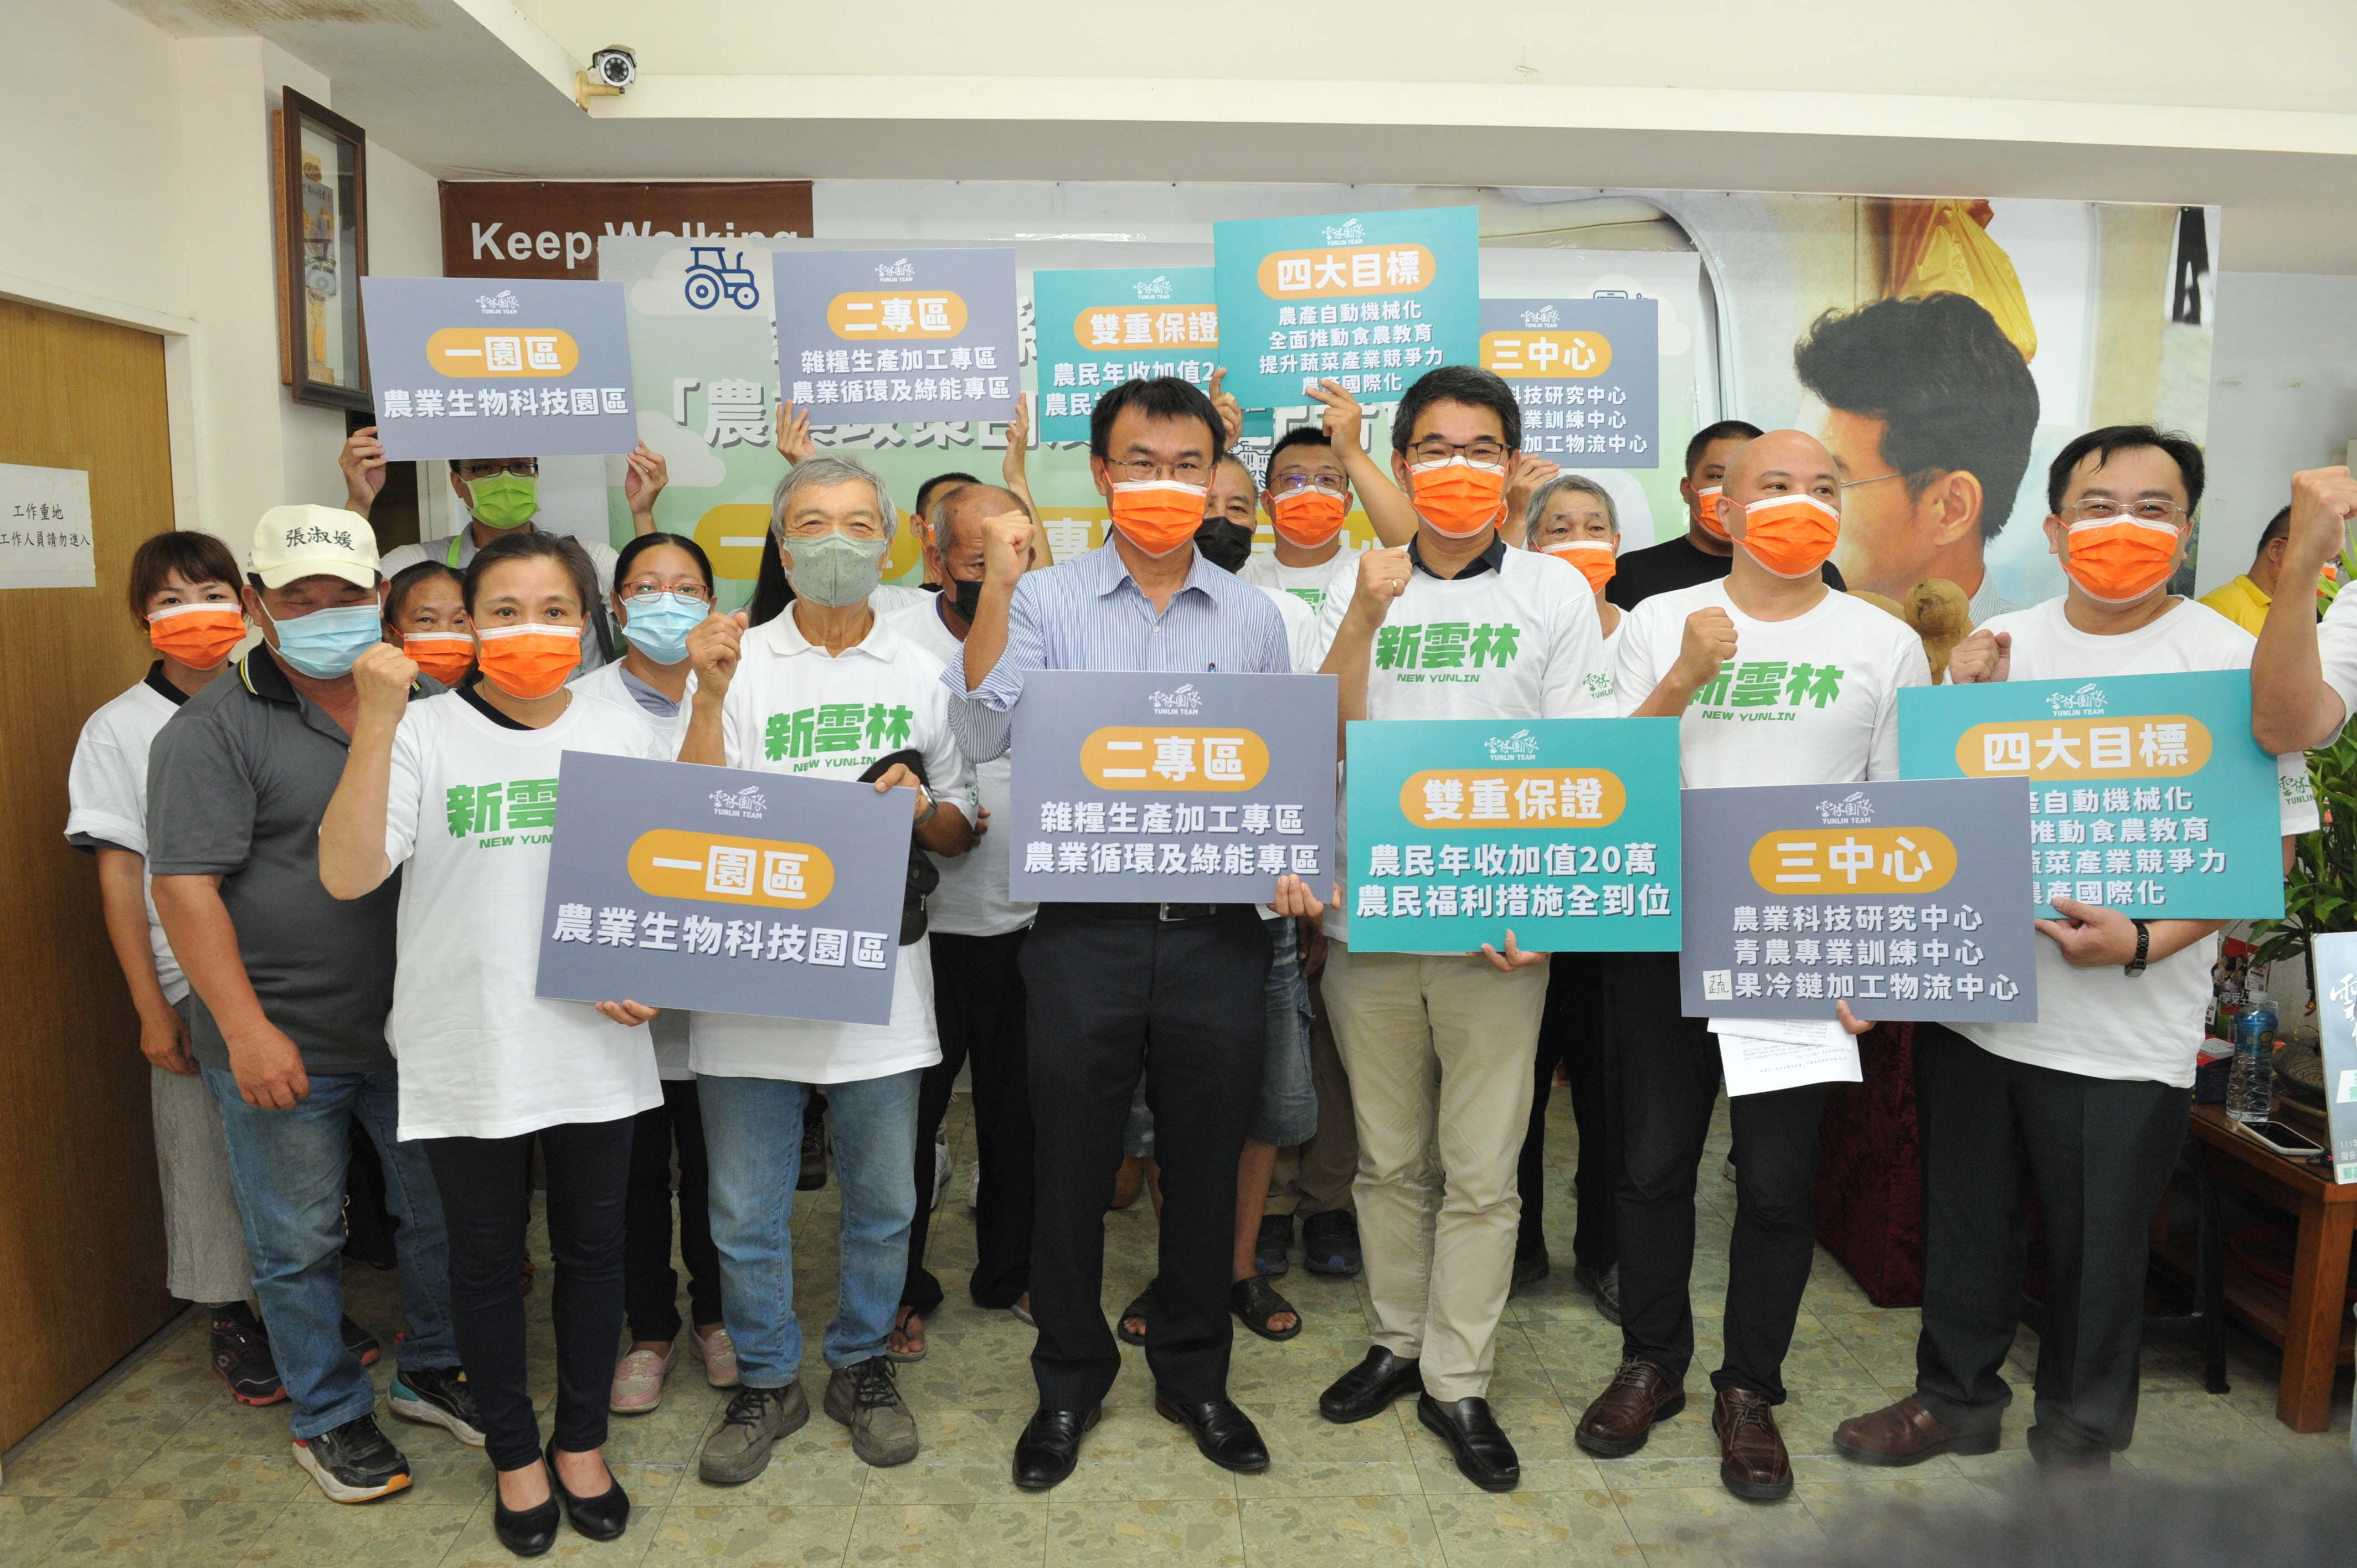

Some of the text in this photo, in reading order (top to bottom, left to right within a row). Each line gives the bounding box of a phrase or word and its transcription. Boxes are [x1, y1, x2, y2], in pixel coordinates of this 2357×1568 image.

[471, 223, 591, 269] Keep
[1278, 251, 1419, 291] 四大目標
[845, 297, 951, 333] 二專區
[1090, 311, 1218, 345] 雙重保證
[1279, 300, 1422, 326] 農產自動機械化
[1269, 324, 1432, 350] 全面推動食農教育
[445, 336, 562, 370] 一園區
[801, 347, 997, 374] 雜糧生產加工專區
[1259, 347, 1443, 374] 提升蔬菜產業競爭力
[1492, 337, 1596, 371] 三中心
[1053, 359, 1221, 387] 農民年收加值2
[384, 388, 629, 418] 農業生物科技園區
[792, 376, 1010, 405] 農業循環及綠能專區
[1046, 391, 1102, 417] 農民
[1520, 435, 1648, 453] 加工物流中心
[13, 503, 64, 520] 工作重地
[0, 531, 91, 547] 工作人員請勿進入
[286, 526, 355, 551] 張淑媛
[1376, 622, 1520, 670] 新雲林
[1397, 673, 1480, 683] NEW YUNLIN
[1702, 710, 1795, 721] NEW YUNLIN
[765, 703, 913, 761] 新雲林
[1984, 723, 2189, 771] 四大目標
[793, 756, 876, 772] NEW YUNLIN
[1103, 736, 1245, 781] 二專區
[714, 808, 762, 819] YUNLIN TEAM
[1423, 777, 1603, 821] 雙重保證
[1041, 802, 1304, 834] 雜糧生產加工專區
[480, 837, 514, 849] NEW
[1024, 842, 1320, 874] 農業循環及綠能專區
[652, 845, 809, 899] 一園區
[1368, 843, 1656, 876] 農民年收加值20萬
[1776, 836, 1933, 884] 三中心
[1356, 883, 1670, 917] 農民福利措施全到位
[1733, 904, 1983, 932] 農業科技研究中心
[552, 902, 888, 969] 農業生物科技園區
[1735, 938, 1984, 966] 青農專業訓練中心
